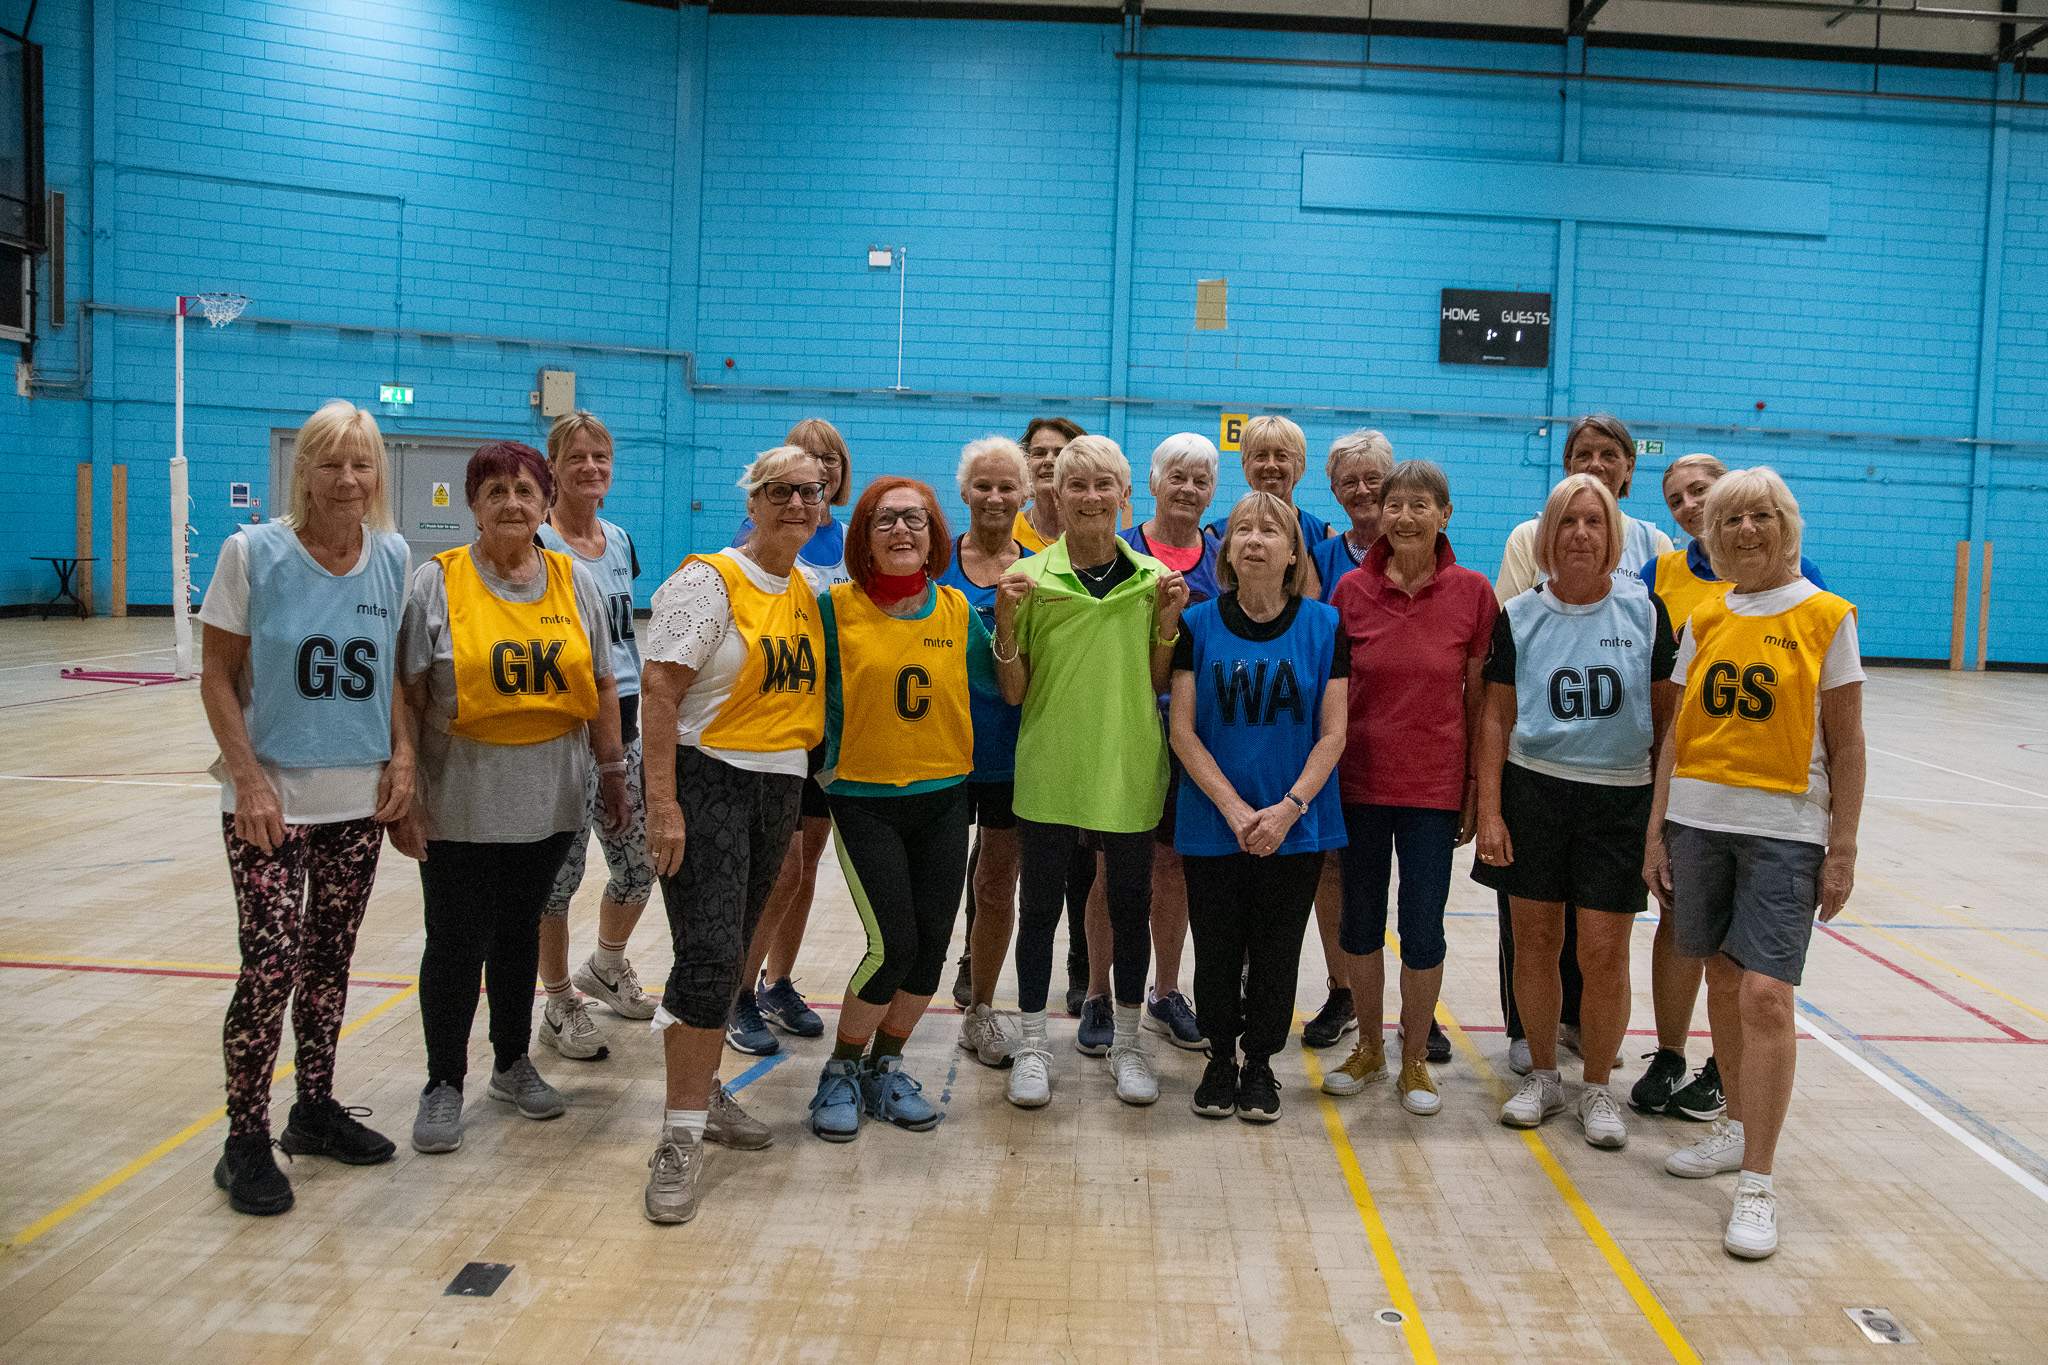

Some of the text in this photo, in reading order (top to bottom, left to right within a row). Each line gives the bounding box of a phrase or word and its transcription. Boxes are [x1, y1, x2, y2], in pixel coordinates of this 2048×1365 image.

[1442, 307, 1550, 325] HOME GUESTS
[1227, 419, 1242, 443] 6
[833, 576, 852, 584] mit
[356, 603, 388, 618] mitre
[540, 614, 571, 625] mitre
[923, 637, 954, 648] mitre
[1600, 636, 1633, 648] mitre
[1763, 635, 1798, 650] mitre
[294, 633, 379, 702] GS
[489, 638, 572, 696] GK
[758, 633, 817, 696] WA
[893, 663, 932, 722] C
[1211, 658, 1306, 727] WA
[1547, 664, 1625, 722] GD
[1700, 659, 1779, 723] GS
